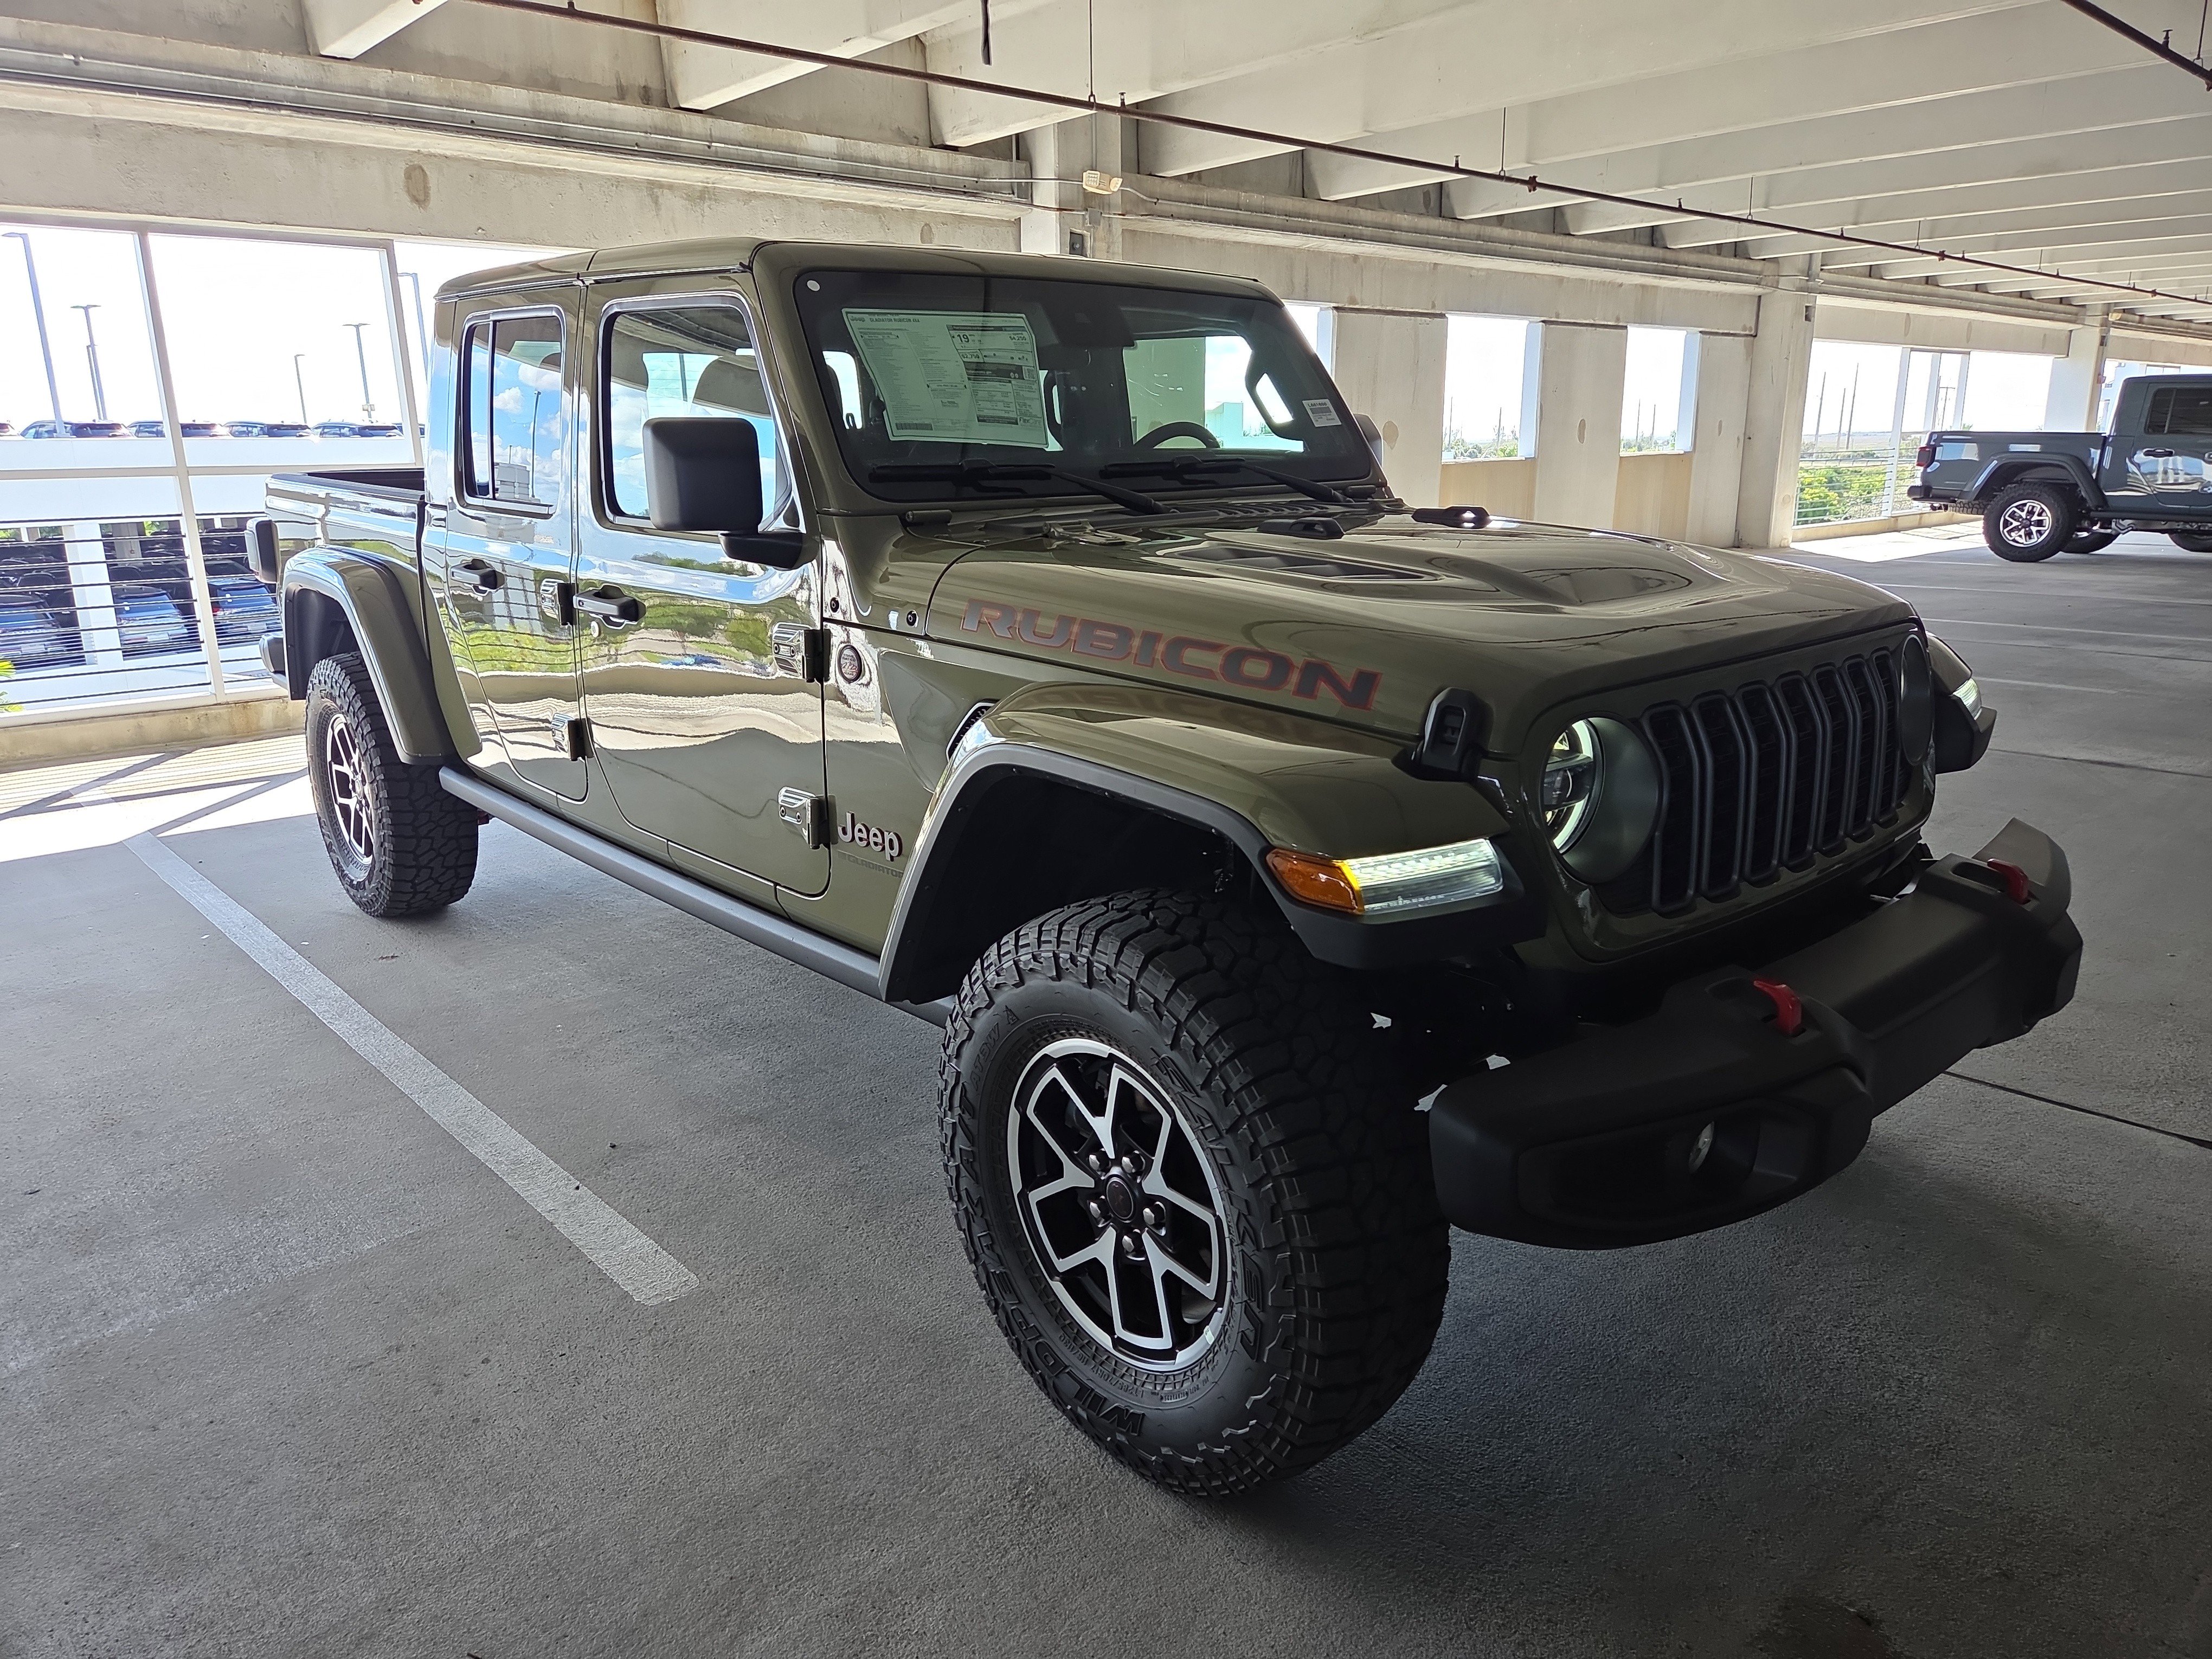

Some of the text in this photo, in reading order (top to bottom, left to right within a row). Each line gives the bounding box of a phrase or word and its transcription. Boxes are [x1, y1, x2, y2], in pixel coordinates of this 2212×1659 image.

[956, 334, 970, 343] 19
[960, 599, 1383, 710] RUBICON
[838, 811, 903, 861] Jeep
[969, 1022, 1000, 1091] AT3W
[962, 1186, 1146, 1436] WILDPEAK
